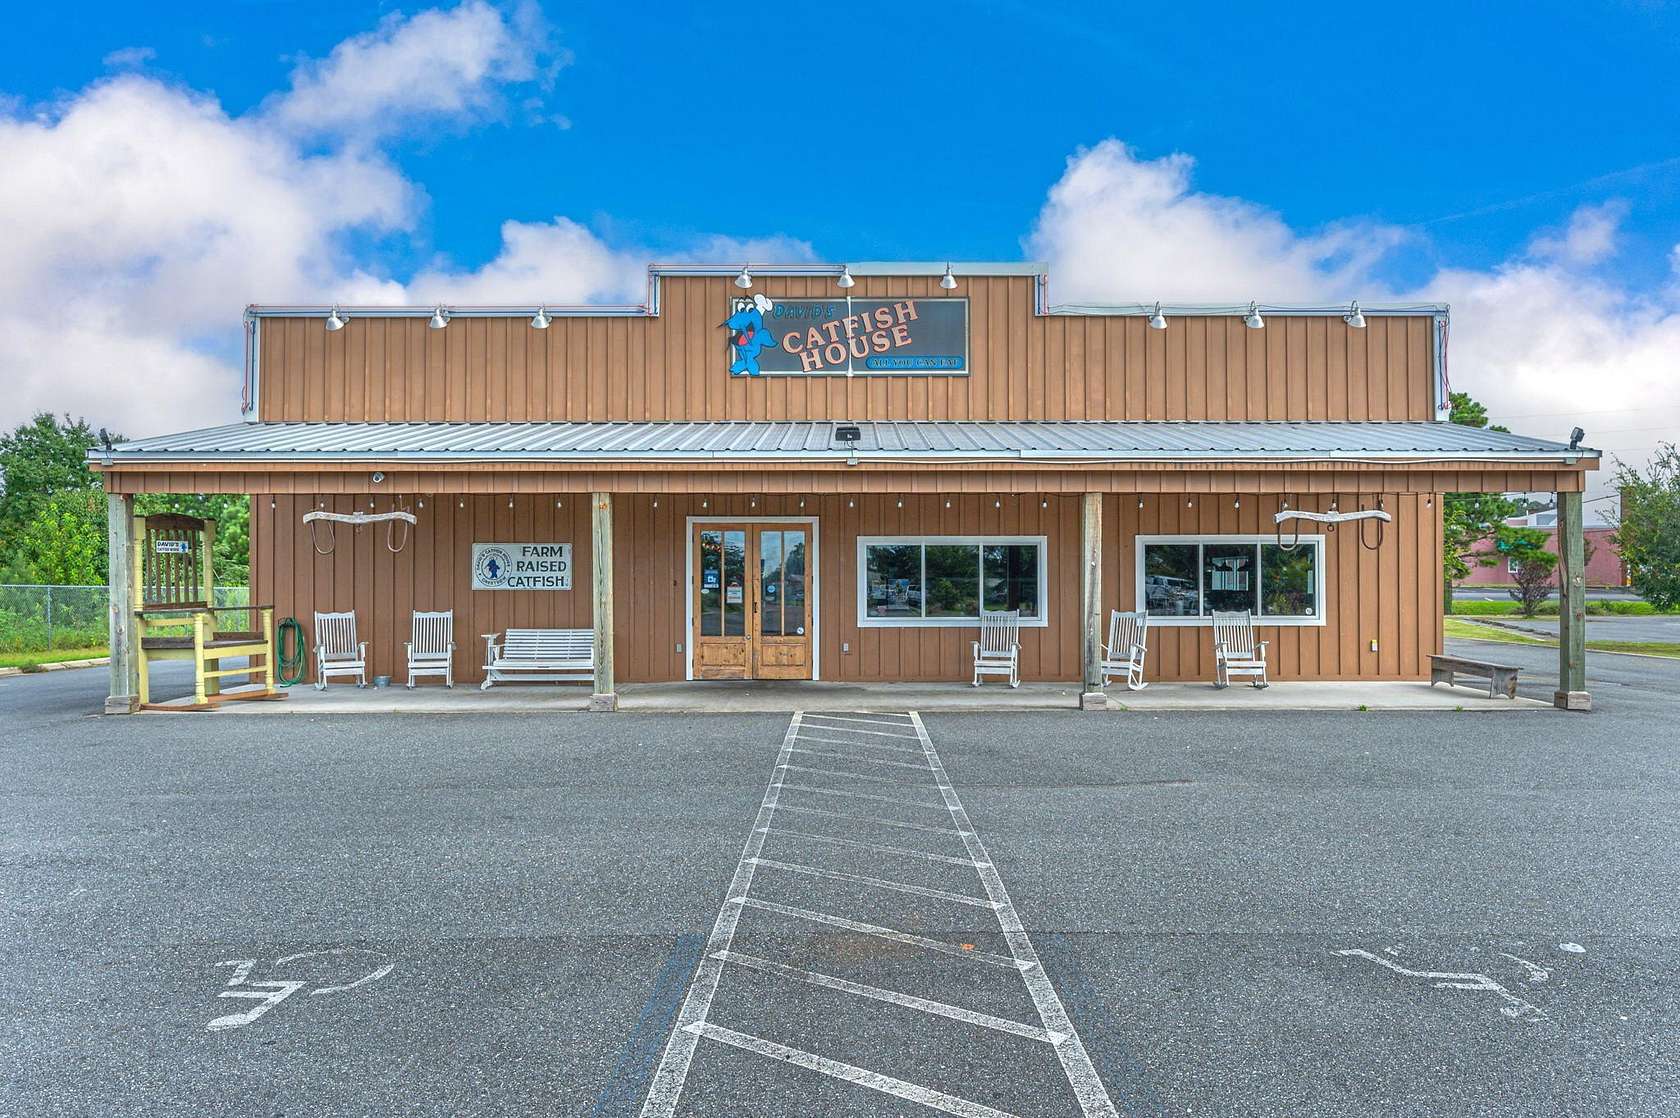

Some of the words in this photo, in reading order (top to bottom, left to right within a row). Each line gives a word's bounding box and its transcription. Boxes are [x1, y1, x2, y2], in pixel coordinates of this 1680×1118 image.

[782, 300, 918, 354] CATFISH
[799, 324, 913, 372] HOUSE
[893, 359, 912, 368] YOU
[916, 359, 936, 368] CAN
[940, 359, 958, 368] EAT
[522, 546, 563, 558] FARM
[516, 561, 567, 572] RAISED
[507, 576, 565, 587] CATFISH
